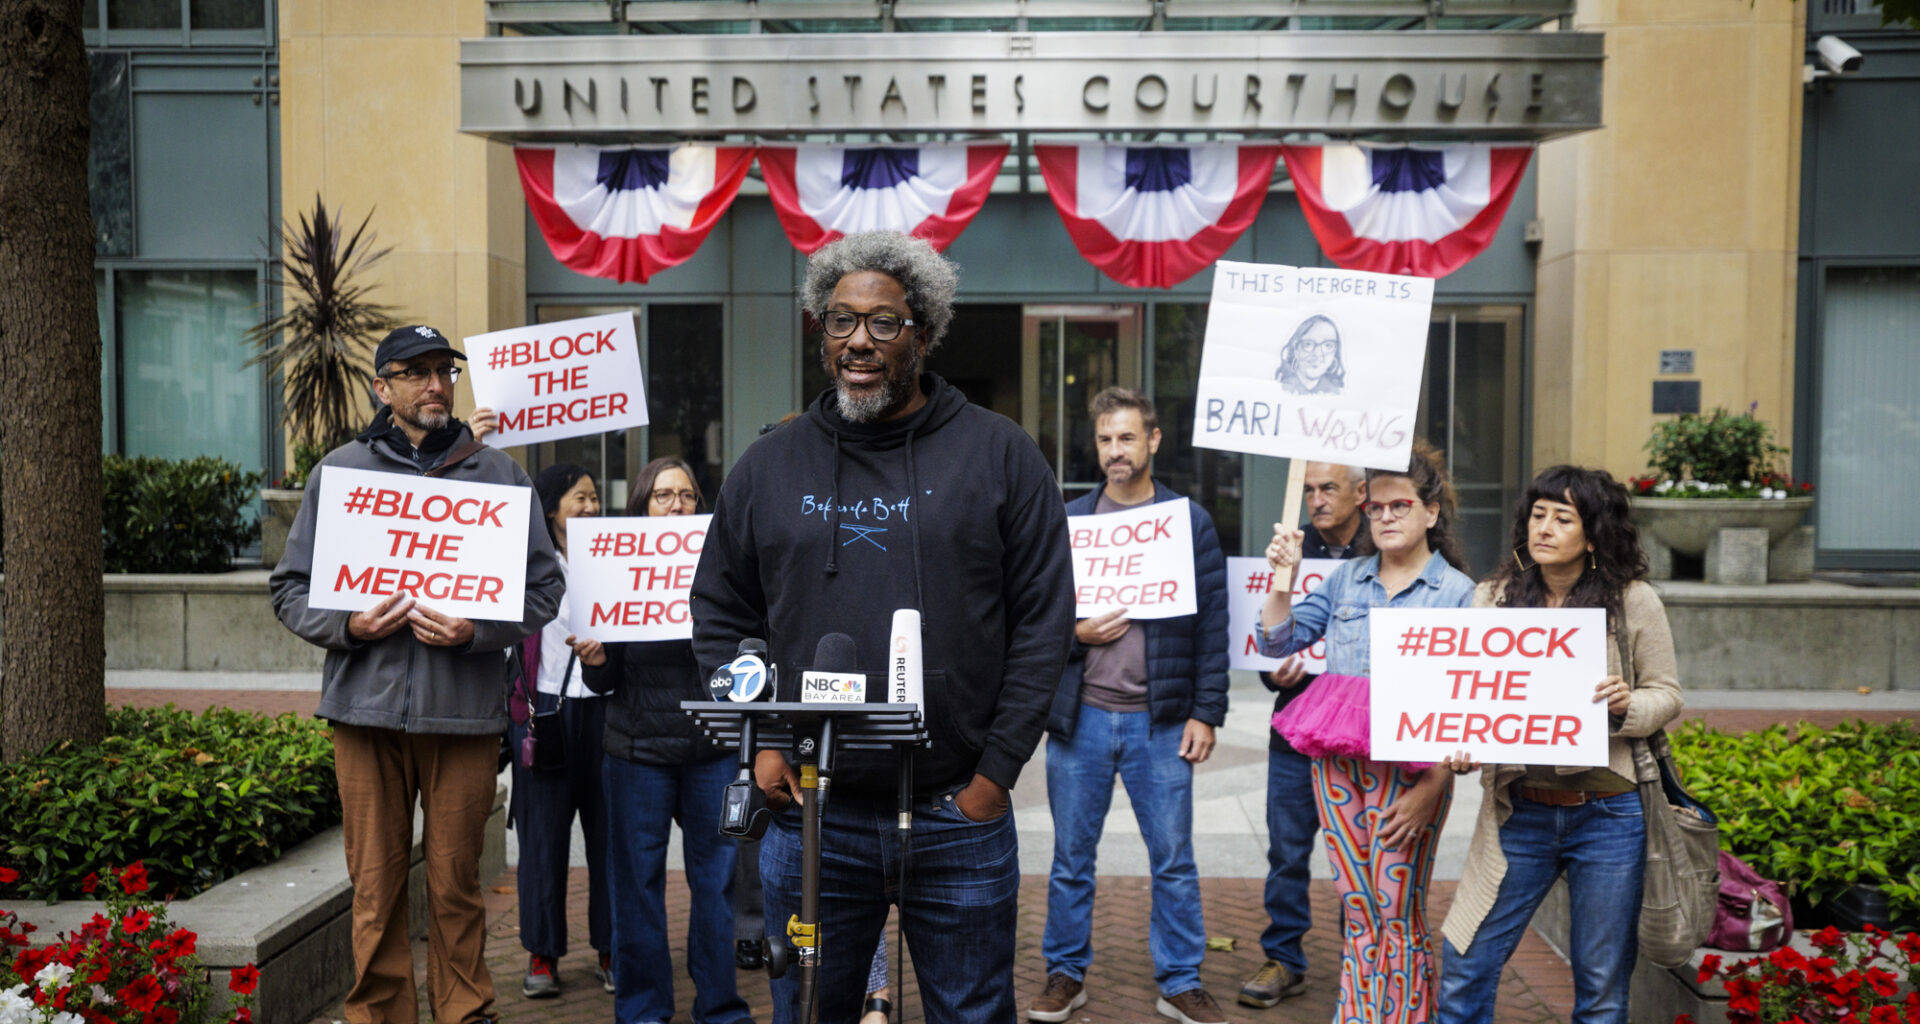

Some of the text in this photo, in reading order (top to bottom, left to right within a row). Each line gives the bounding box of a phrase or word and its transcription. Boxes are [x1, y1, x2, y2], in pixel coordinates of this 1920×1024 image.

[514, 73, 1545, 116] UNITED STATES COURTHOUSE
[1226, 271, 1412, 299] THIS MERGER IS
[488, 328, 617, 370] #BLOCK
[528, 366, 589, 397] THE
[498, 393, 629, 435] MERGER
[1206, 399, 1406, 452] BARI WRONG
[344, 486, 509, 528] #BLOCK
[388, 529, 464, 562] THE
[589, 530, 705, 557] #BLOC
[1070, 515, 1173, 549] BLOCK
[628, 565, 694, 591] THE
[1085, 553, 1144, 577] THE
[333, 564, 504, 604] MERGER
[1076, 580, 1178, 606] ERGER
[589, 599, 694, 627] MERG
[1397, 626, 1580, 659] #BLOCK
[710, 676, 733, 688] abc
[805, 678, 840, 692] NBC
[896, 657, 906, 703] REUTER
[1445, 669, 1532, 701] THE
[804, 692, 862, 703] BAY AREA
[1396, 711, 1583, 746] MERGER
